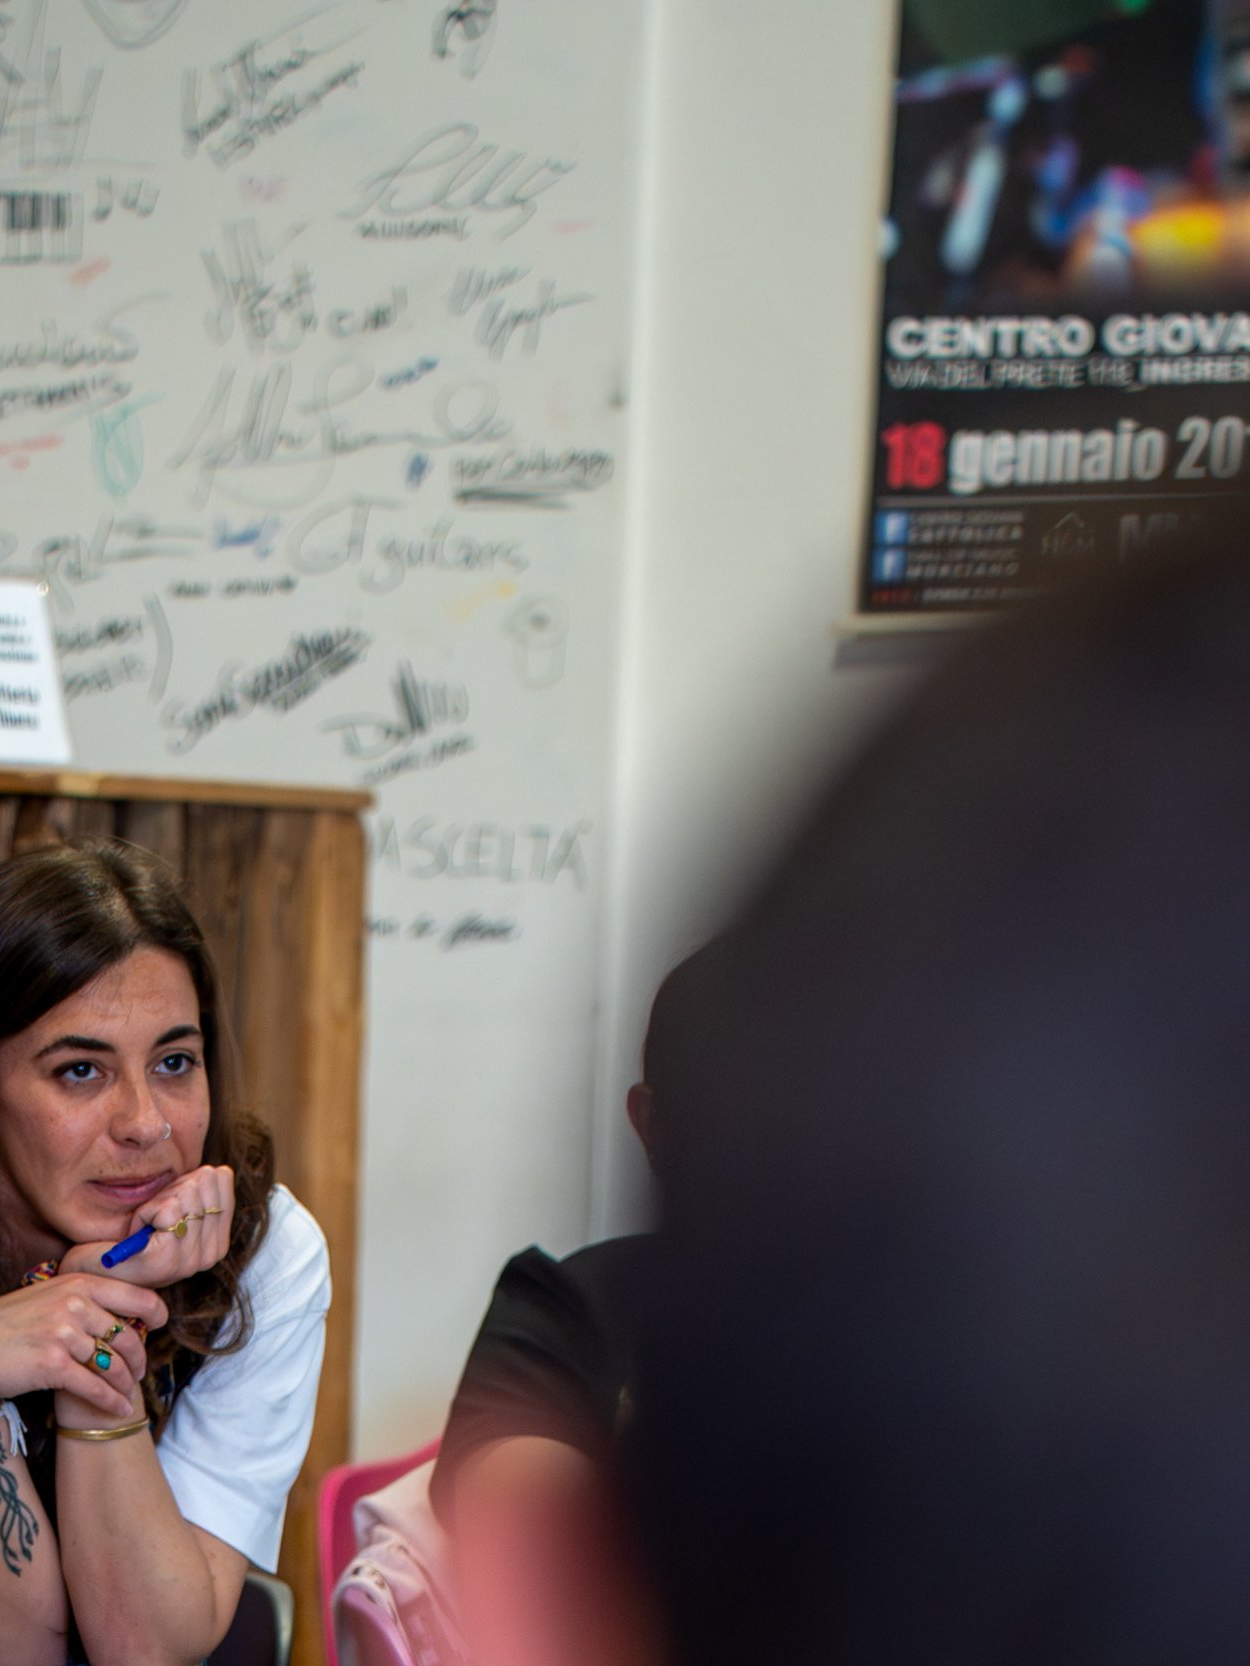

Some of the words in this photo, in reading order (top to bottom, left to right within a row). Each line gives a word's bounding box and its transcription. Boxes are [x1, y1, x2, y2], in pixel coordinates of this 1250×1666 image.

[886, 314, 1095, 360] CENTRO
[942, 359, 990, 390] DEL
[992, 358, 1086, 389] PRETE
[882, 420, 946, 489] 18
[947, 416, 1169, 496] gennaio
[1174, 413, 1250, 481] 20
